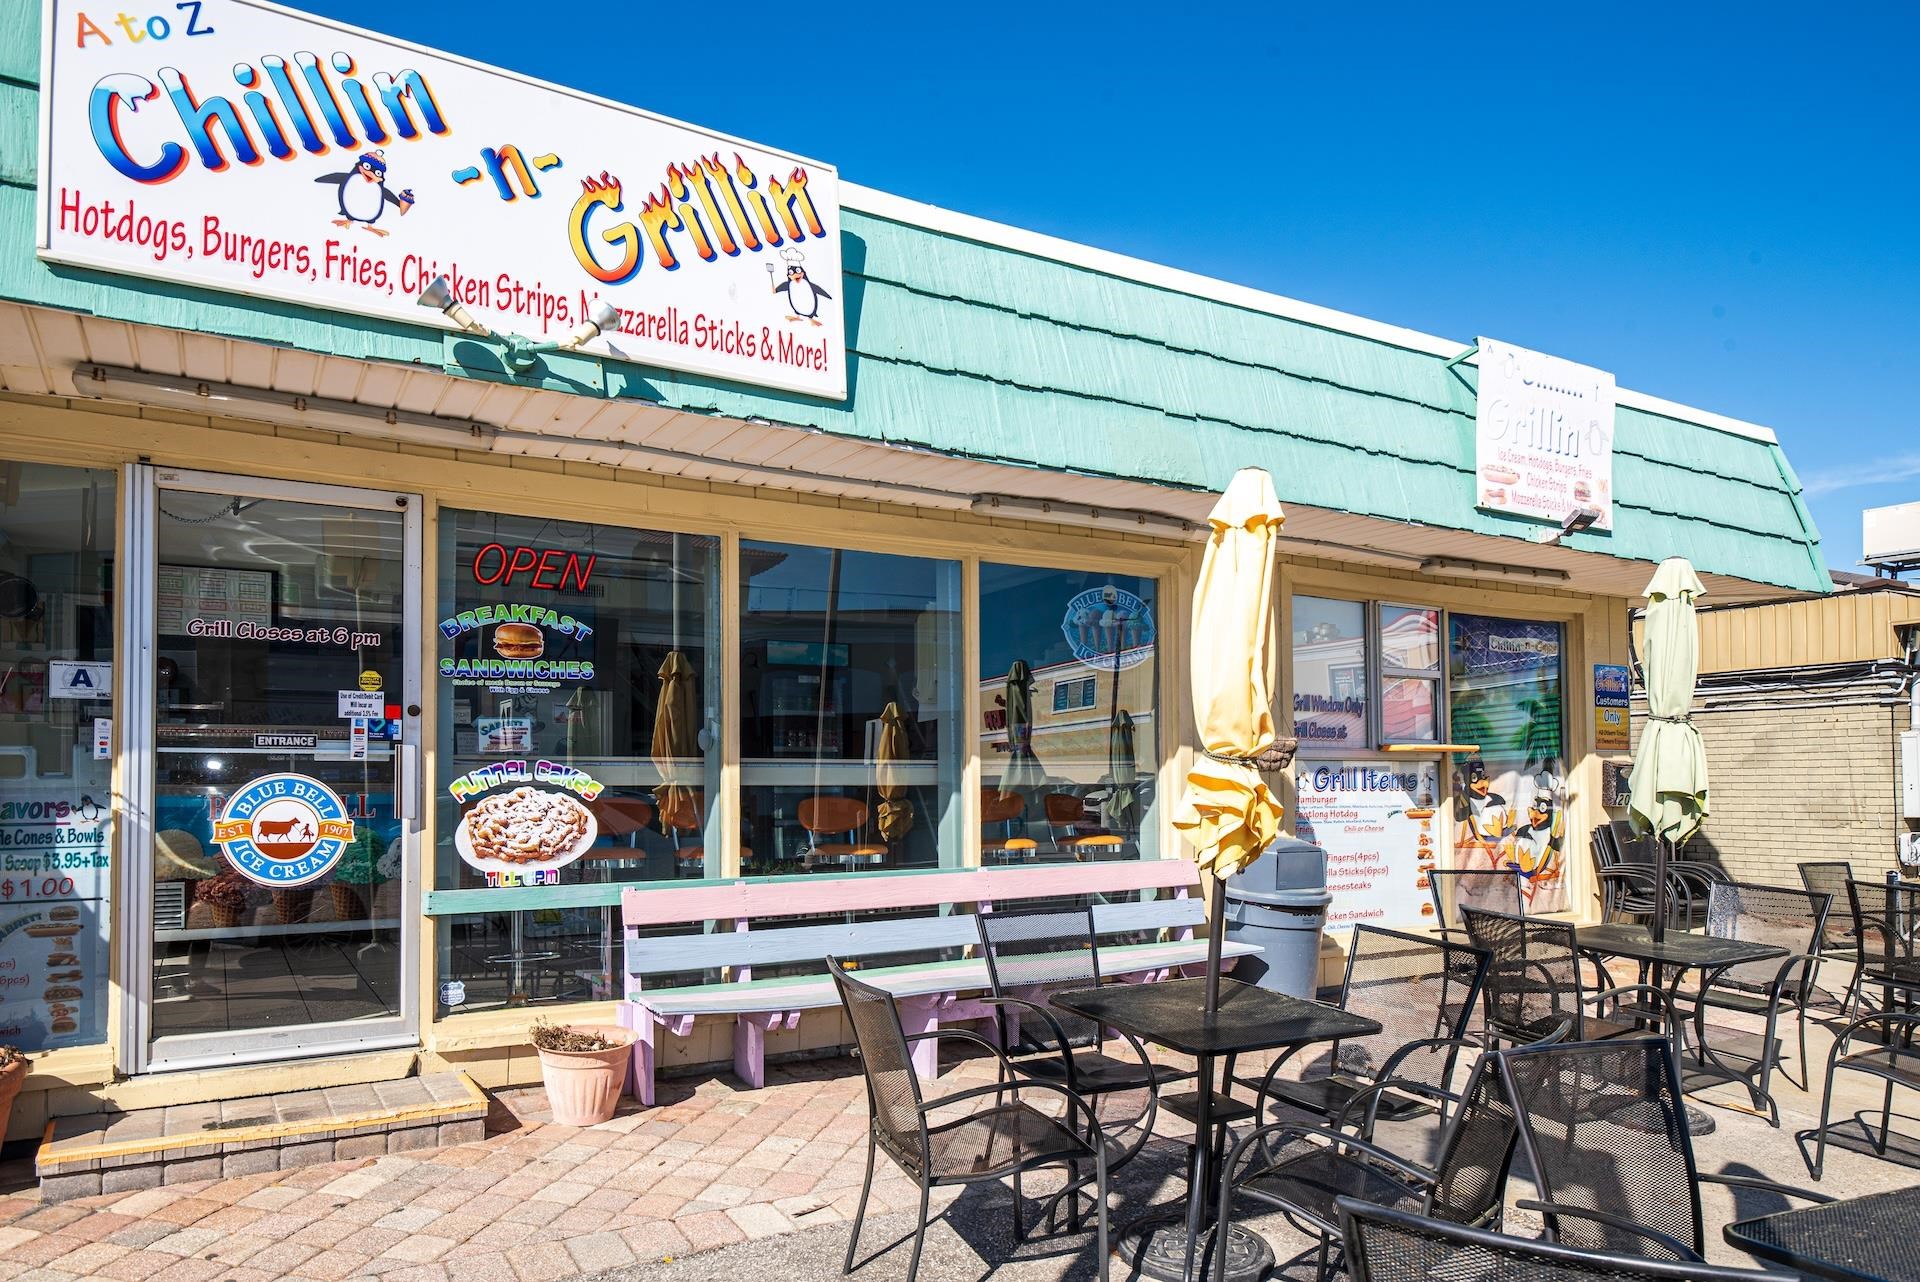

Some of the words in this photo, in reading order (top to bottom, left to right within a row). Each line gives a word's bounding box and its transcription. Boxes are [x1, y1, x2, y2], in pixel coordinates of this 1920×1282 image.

[76, 12, 112, 49] A
[115, 12, 171, 44] to
[176, 1, 215, 37] Z
[89, 50, 452, 185] Chillin
[452, 143, 562, 203] -n-
[568, 151, 826, 286] Grillin
[58, 187, 195, 261] Hotdogs,
[203, 214, 317, 281] Burgers,
[325, 239, 394, 296] Fries,
[496, 273, 574, 335] Strips,
[581, 289, 689, 345] Mzzarella
[694, 313, 757, 357] Sticks
[760, 327, 775, 360] &
[777, 329, 830, 372] More!
[472, 543, 597, 593] OPEN
[1073, 592, 1101, 611] BLUE
[187, 619, 232, 638] Grill
[236, 622, 303, 642] Closes
[306, 627, 330, 643] at
[332, 628, 349, 643] 6
[351, 630, 381, 650] pm
[439, 604, 593, 642] BREAKFAST
[70, 669, 94, 688] A
[439, 658, 595, 680] SANDWICHES
[1294, 693, 1310, 712] Grill
[1311, 695, 1344, 713] Window
[1345, 696, 1364, 718] Only
[1596, 695, 1628, 706] Customers
[1603, 709, 1621, 727] Only
[257, 736, 315, 747] ENTRANCE
[1313, 766, 1357, 792] Grill
[1361, 767, 1419, 792] Items
[235, 781, 287, 818] BLUE
[291, 782, 334, 820] BELL
[1330, 810, 1358, 819] Hotdog
[15, 829, 53, 845] Cones
[55, 828, 65, 843] &
[68, 828, 104, 843] Bowls
[218, 824, 246, 839] EST
[322, 824, 350, 838] 1907
[1364, 825, 1385, 833] Cheese
[5, 855, 41, 876] Scoop
[234, 842, 262, 872] ICE
[268, 842, 337, 879] CREAM
[1349, 908, 1384, 919] Sandwich
